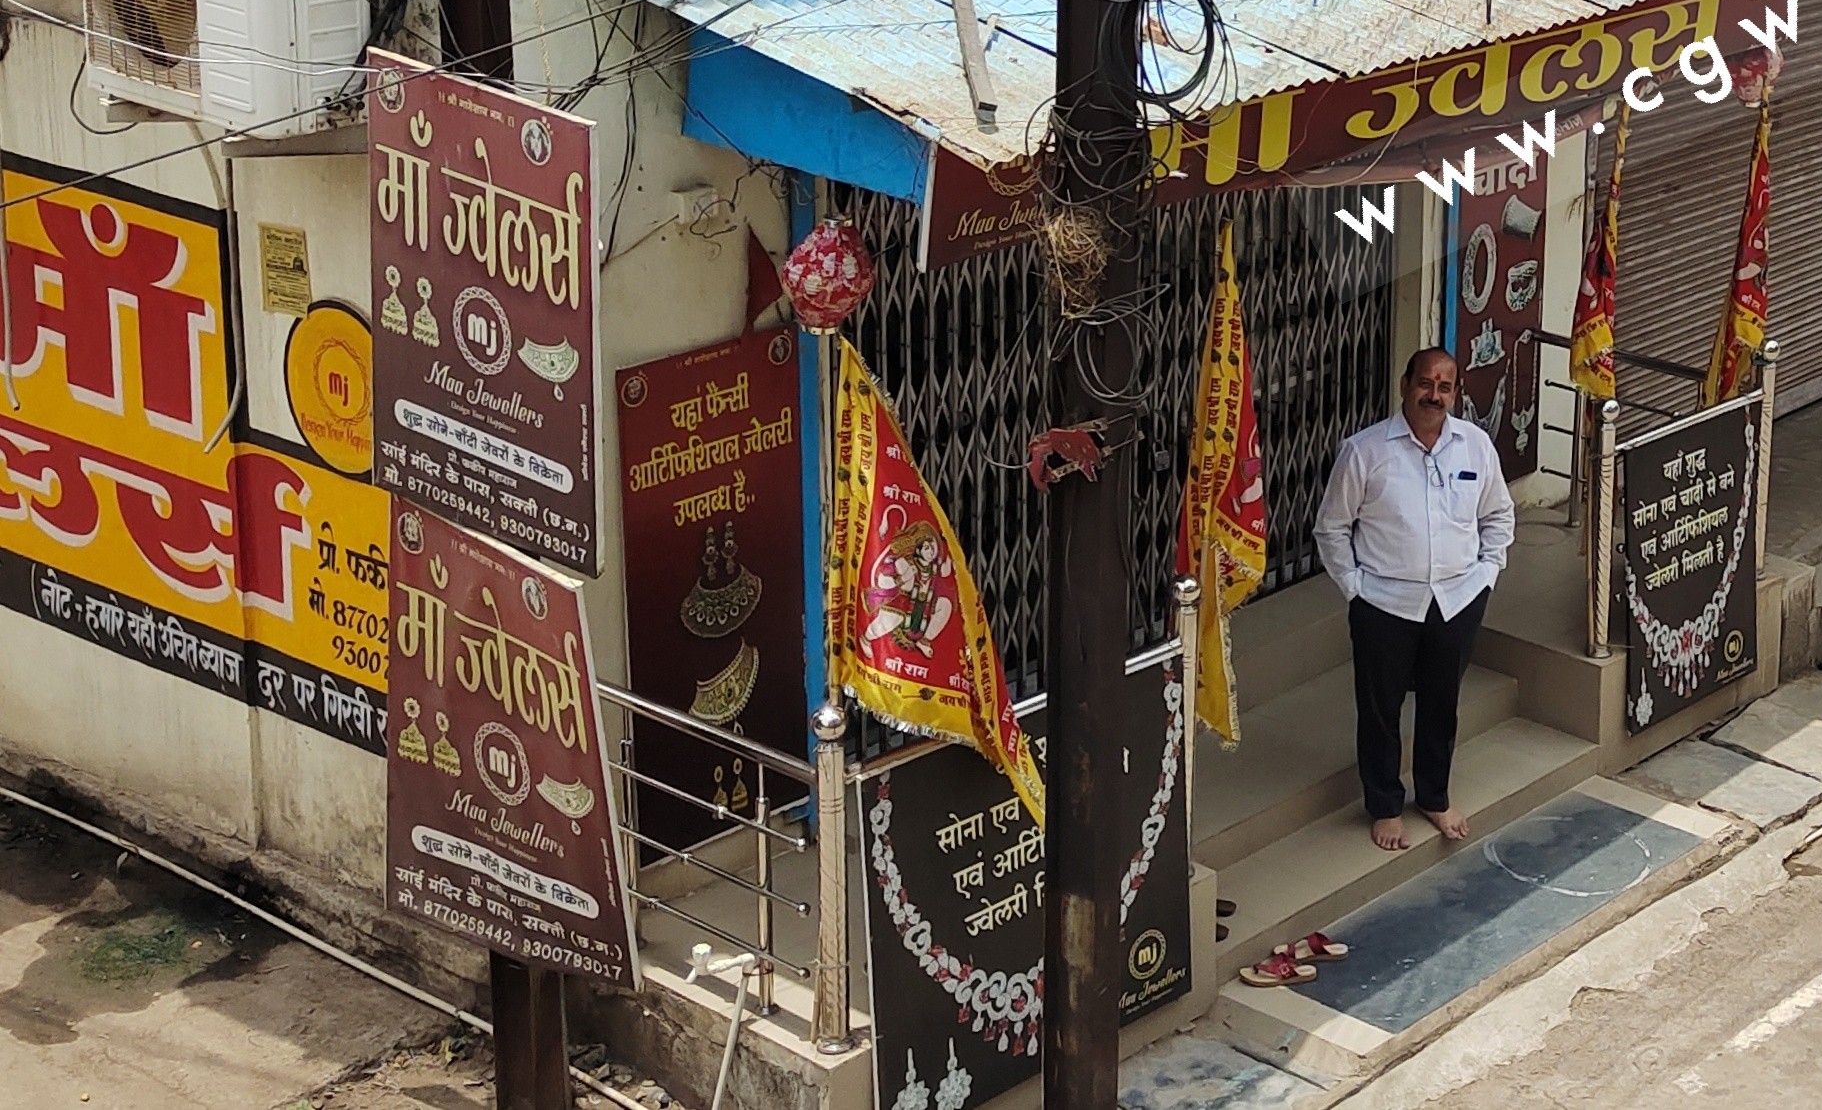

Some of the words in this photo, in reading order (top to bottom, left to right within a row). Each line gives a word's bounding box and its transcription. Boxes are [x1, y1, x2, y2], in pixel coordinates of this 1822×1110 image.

[376, 109, 434, 252] माँ
[441, 137, 584, 310] ज्वेलर्स
[2, 203, 206, 427] माँ
[467, 313, 498, 356] mj
[424, 360, 463, 396] Maa
[466, 378, 544, 429] Jewellers
[742, 406, 793, 456] ज्वेलरी
[381, 439, 407, 468] सांई
[410, 449, 441, 479] मंदिर
[445, 462, 460, 486] के
[464, 473, 495, 505] पास,
[499, 489, 539, 519] सक्ती
[513, 450, 526, 467] के
[385, 465, 403, 487] मो.
[407, 476, 495, 529] 8770259442,
[500, 513, 588, 564] 9300793017
[673, 484, 732, 527] उपलब्ध
[1632, 500, 1657, 530] सोना
[1706, 470, 1717, 496] से
[1719, 463, 1735, 490] बने
[318, 522, 341, 575] प्रो.
[308, 577, 330, 620] मो.
[85, 593, 126, 647] हमारे
[127, 606, 156, 660] यहाँ
[291, 672, 317, 722] पर
[320, 673, 374, 741] गिरवी
[396, 553, 449, 688] माँ
[453, 586, 588, 754] ज्वेलर्स
[489, 746, 517, 788] mj
[445, 789, 487, 823] Maa
[490, 807, 565, 859] Jewellers
[936, 812, 985, 853] सोना
[466, 885, 482, 908] के
[953, 849, 985, 897] एवं
[964, 883, 1029, 937] ज्वेलरी
[424, 899, 516, 952] 8770259442,
[522, 937, 622, 981] 9300793017
